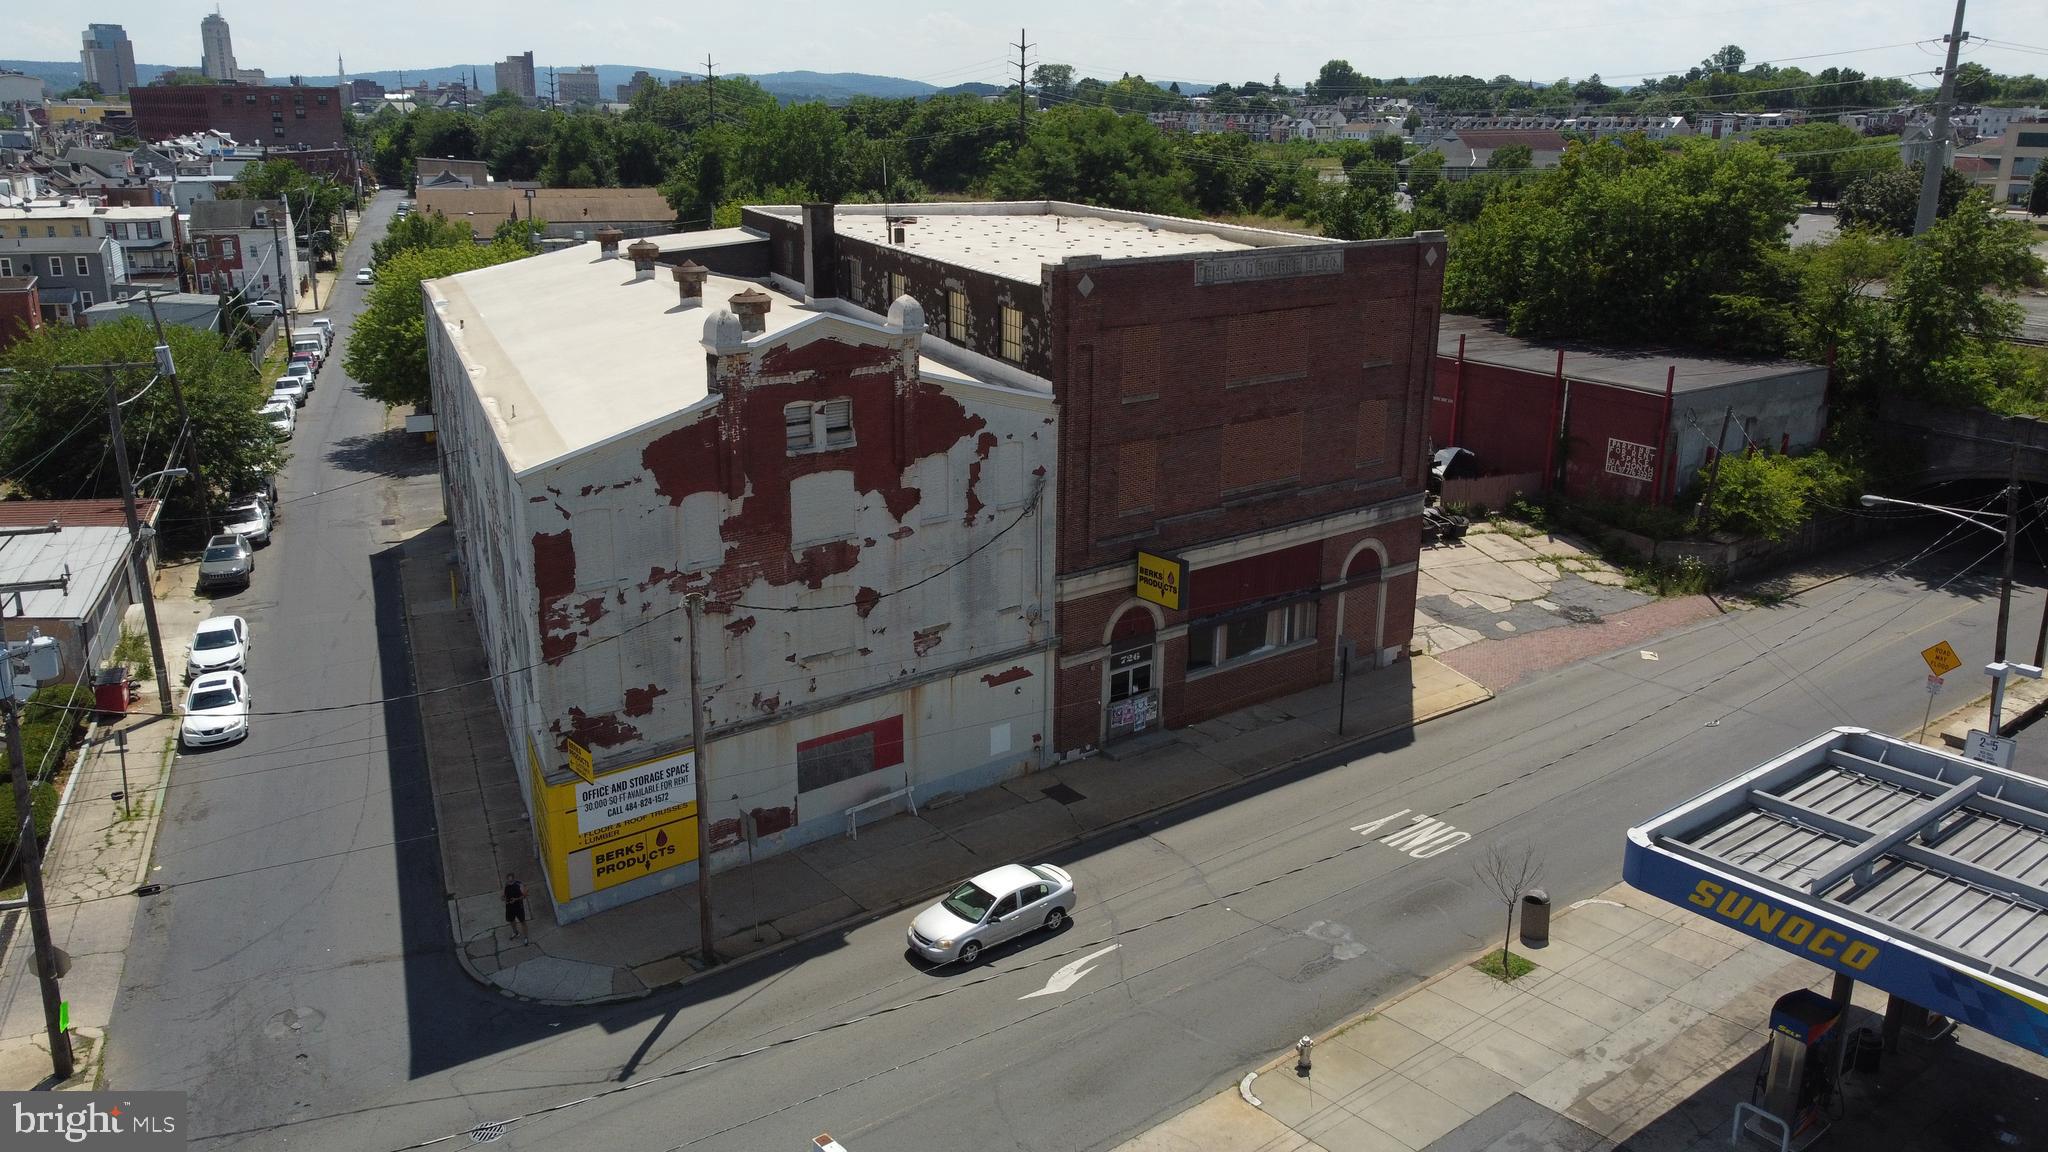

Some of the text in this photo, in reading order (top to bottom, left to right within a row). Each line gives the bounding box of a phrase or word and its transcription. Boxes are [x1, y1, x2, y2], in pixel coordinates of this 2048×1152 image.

[1621, 454, 1650, 465] SPACE
[1631, 450, 1656, 461] RENT
[1139, 566, 1163, 580] BERKS
[1139, 574, 1177, 594] PRODUCTS
[1120, 652, 1141, 665] 726
[1935, 647, 1951, 657] ROAD
[1979, 736, 1986, 748] 2
[582, 762, 690, 802] OFFICE AND STORAGE SPACE
[608, 795, 618, 808] SQ
[619, 793, 627, 804] FT
[627, 782, 661, 800] AVAILABLE
[661, 780, 673, 792] FOR
[674, 775, 689, 788] RENT
[607, 805, 624, 818] CALL
[584, 824, 614, 838] FLOOR
[624, 814, 648, 826] ROOF
[650, 802, 689, 818] TRUSSES
[584, 829, 620, 845] LUMBER
[595, 842, 645, 864] BERKS
[596, 844, 676, 877] PRODUCTS
[1688, 879, 1880, 970] SUNOCO
